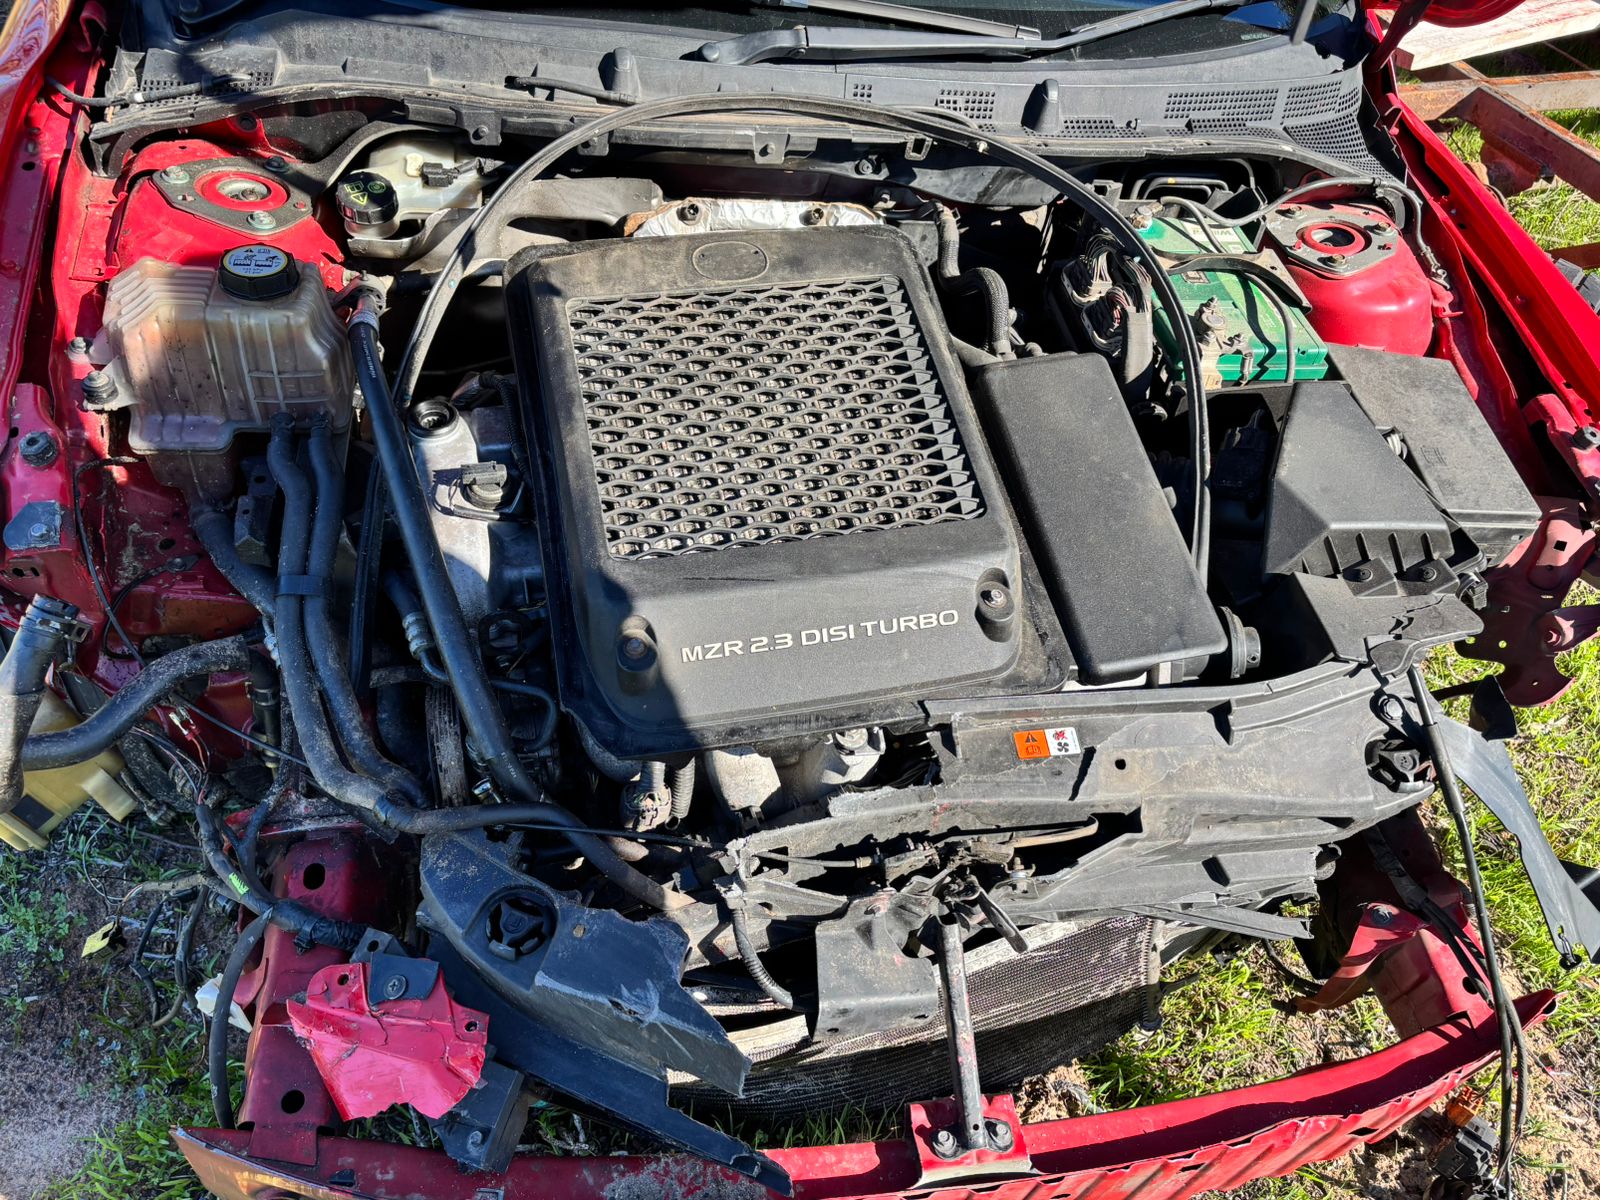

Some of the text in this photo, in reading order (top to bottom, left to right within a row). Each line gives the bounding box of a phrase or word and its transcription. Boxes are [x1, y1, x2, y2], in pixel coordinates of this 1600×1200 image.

[681, 609, 959, 663] MZR 2.3 DISI TURBO
